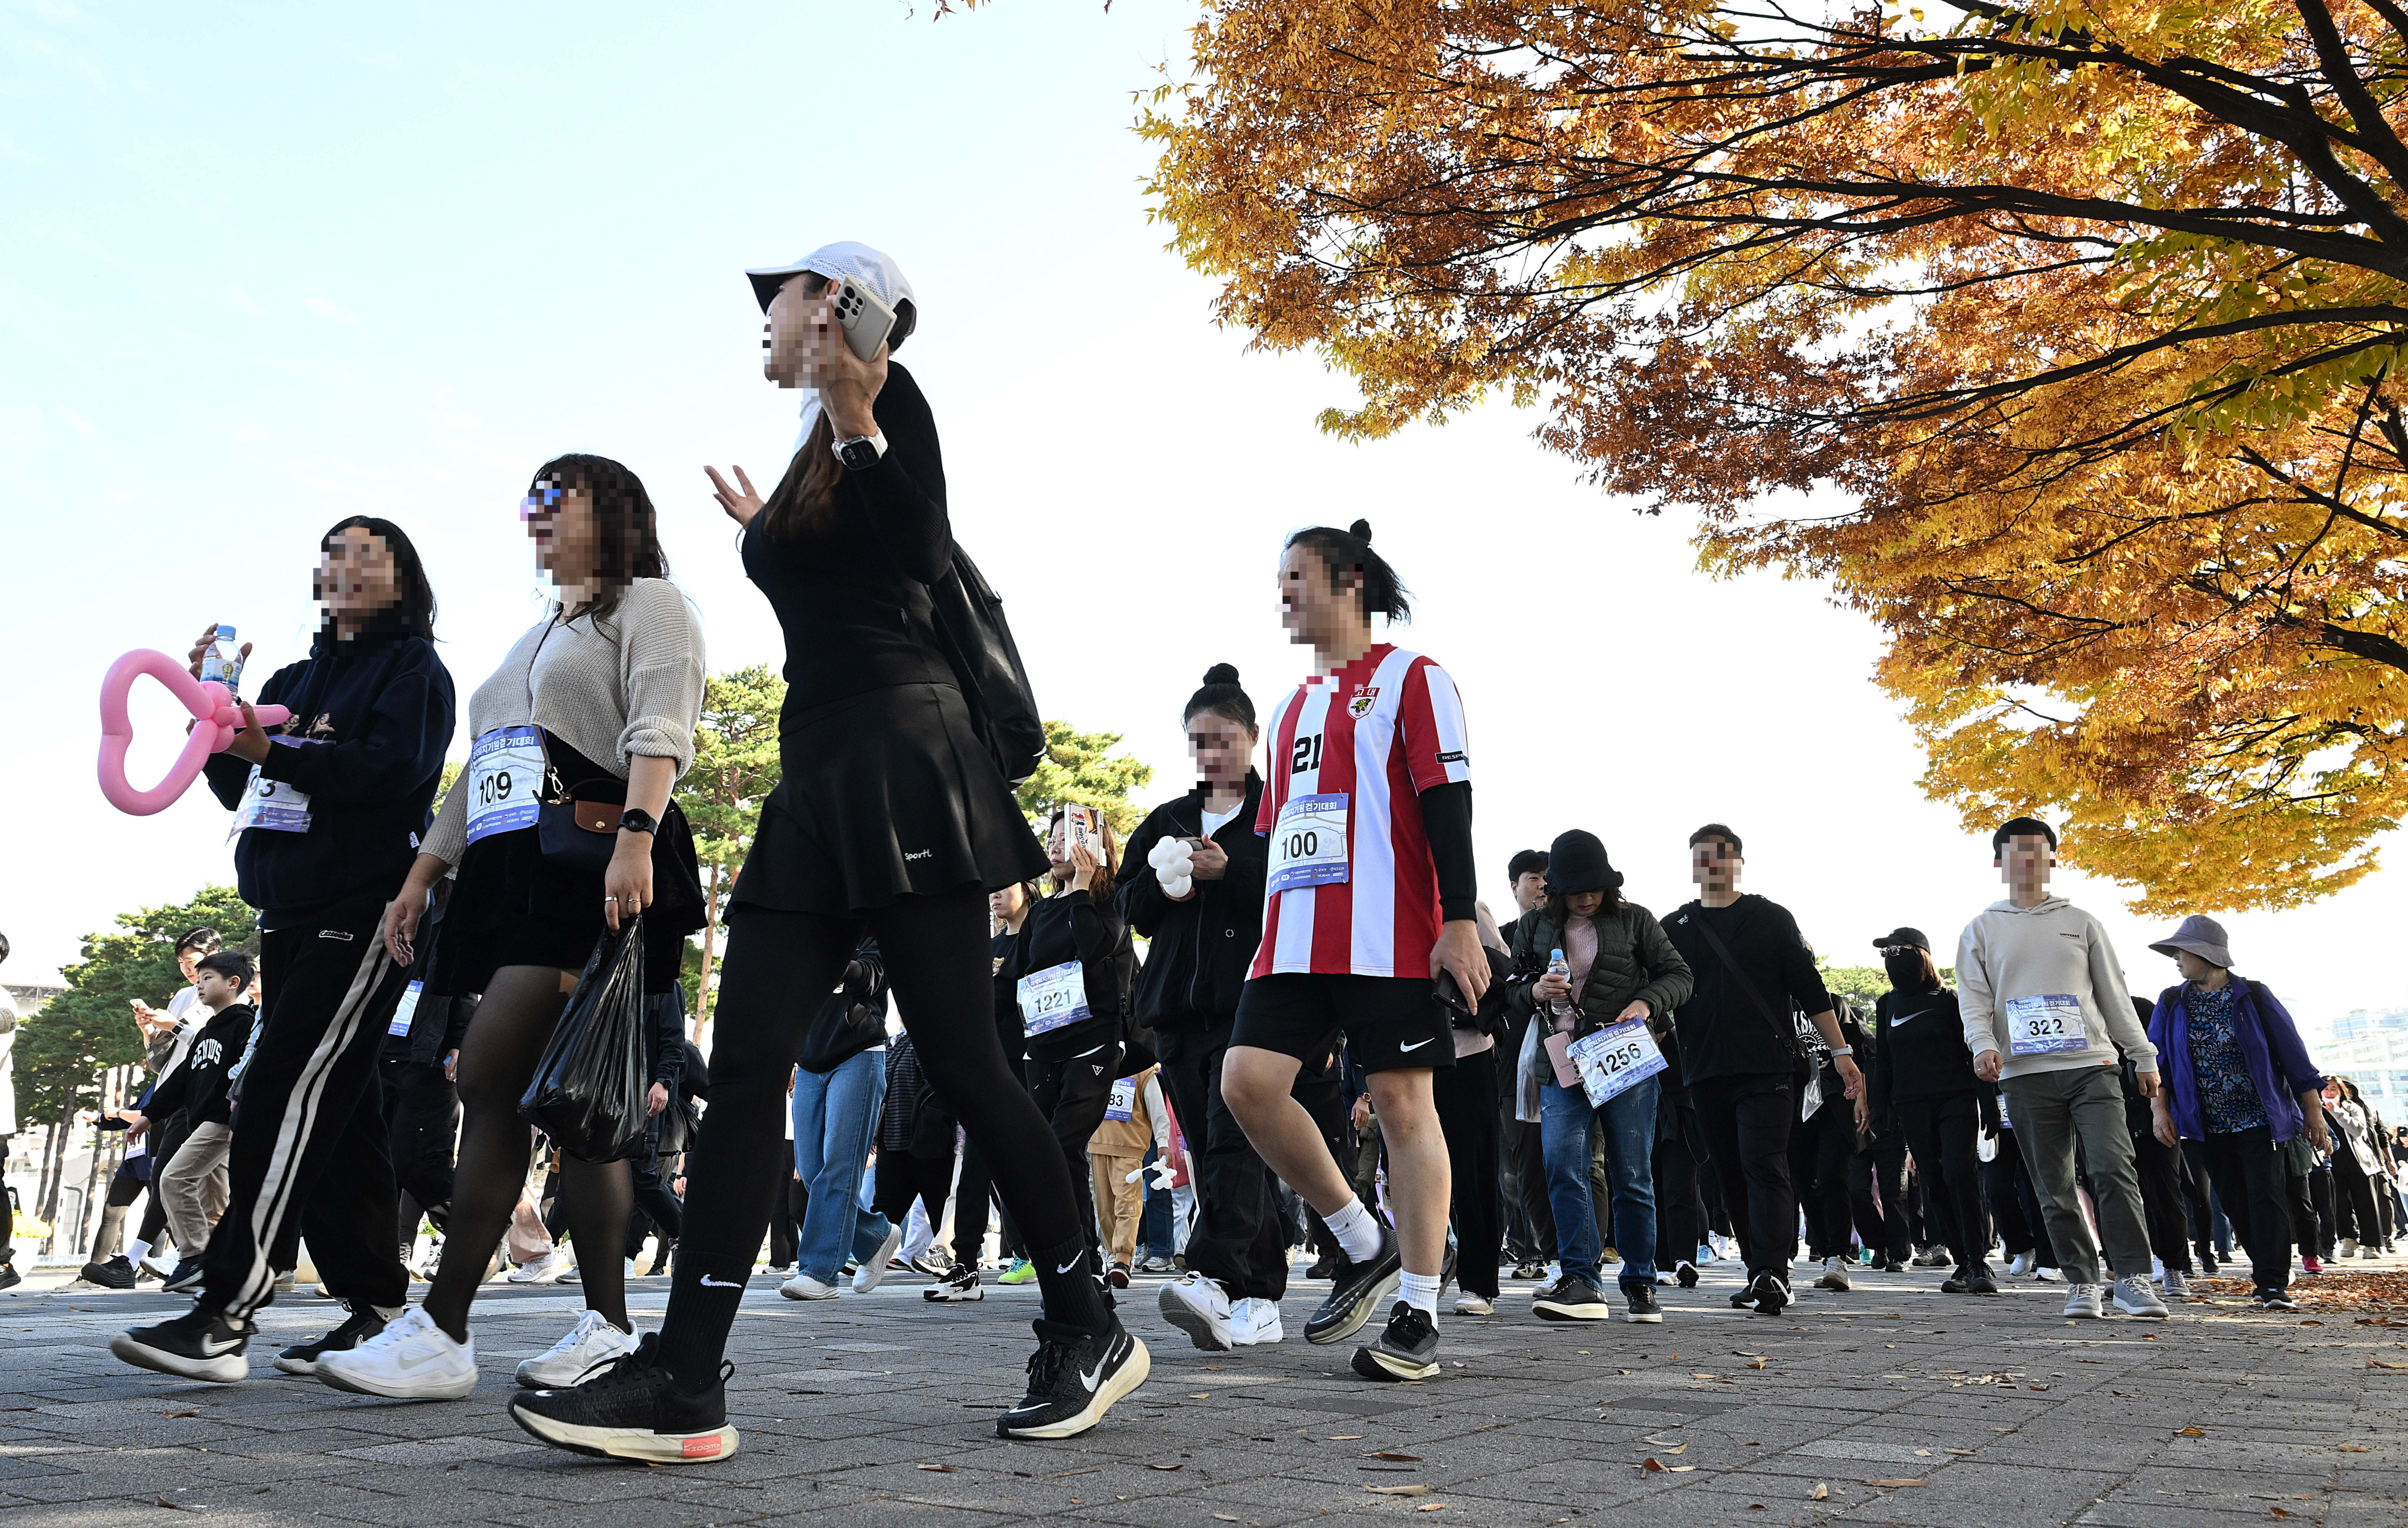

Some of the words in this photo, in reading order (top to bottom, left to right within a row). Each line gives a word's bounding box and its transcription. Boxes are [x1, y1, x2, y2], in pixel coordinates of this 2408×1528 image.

[1292, 733, 1321, 775] 21
[480, 772, 512, 807] 109
[1305, 801, 1337, 812] 걷기대회
[1282, 831, 1317, 860] 100
[1034, 989, 1070, 1013] 1221
[1580, 1036, 1592, 1046] 2024
[1582, 1032, 1613, 1051] 마약퇴치기원
[1613, 1023, 1637, 1036] 걷기대회
[2029, 1019, 2064, 1036] 322
[1596, 1043, 1642, 1076] 1256
